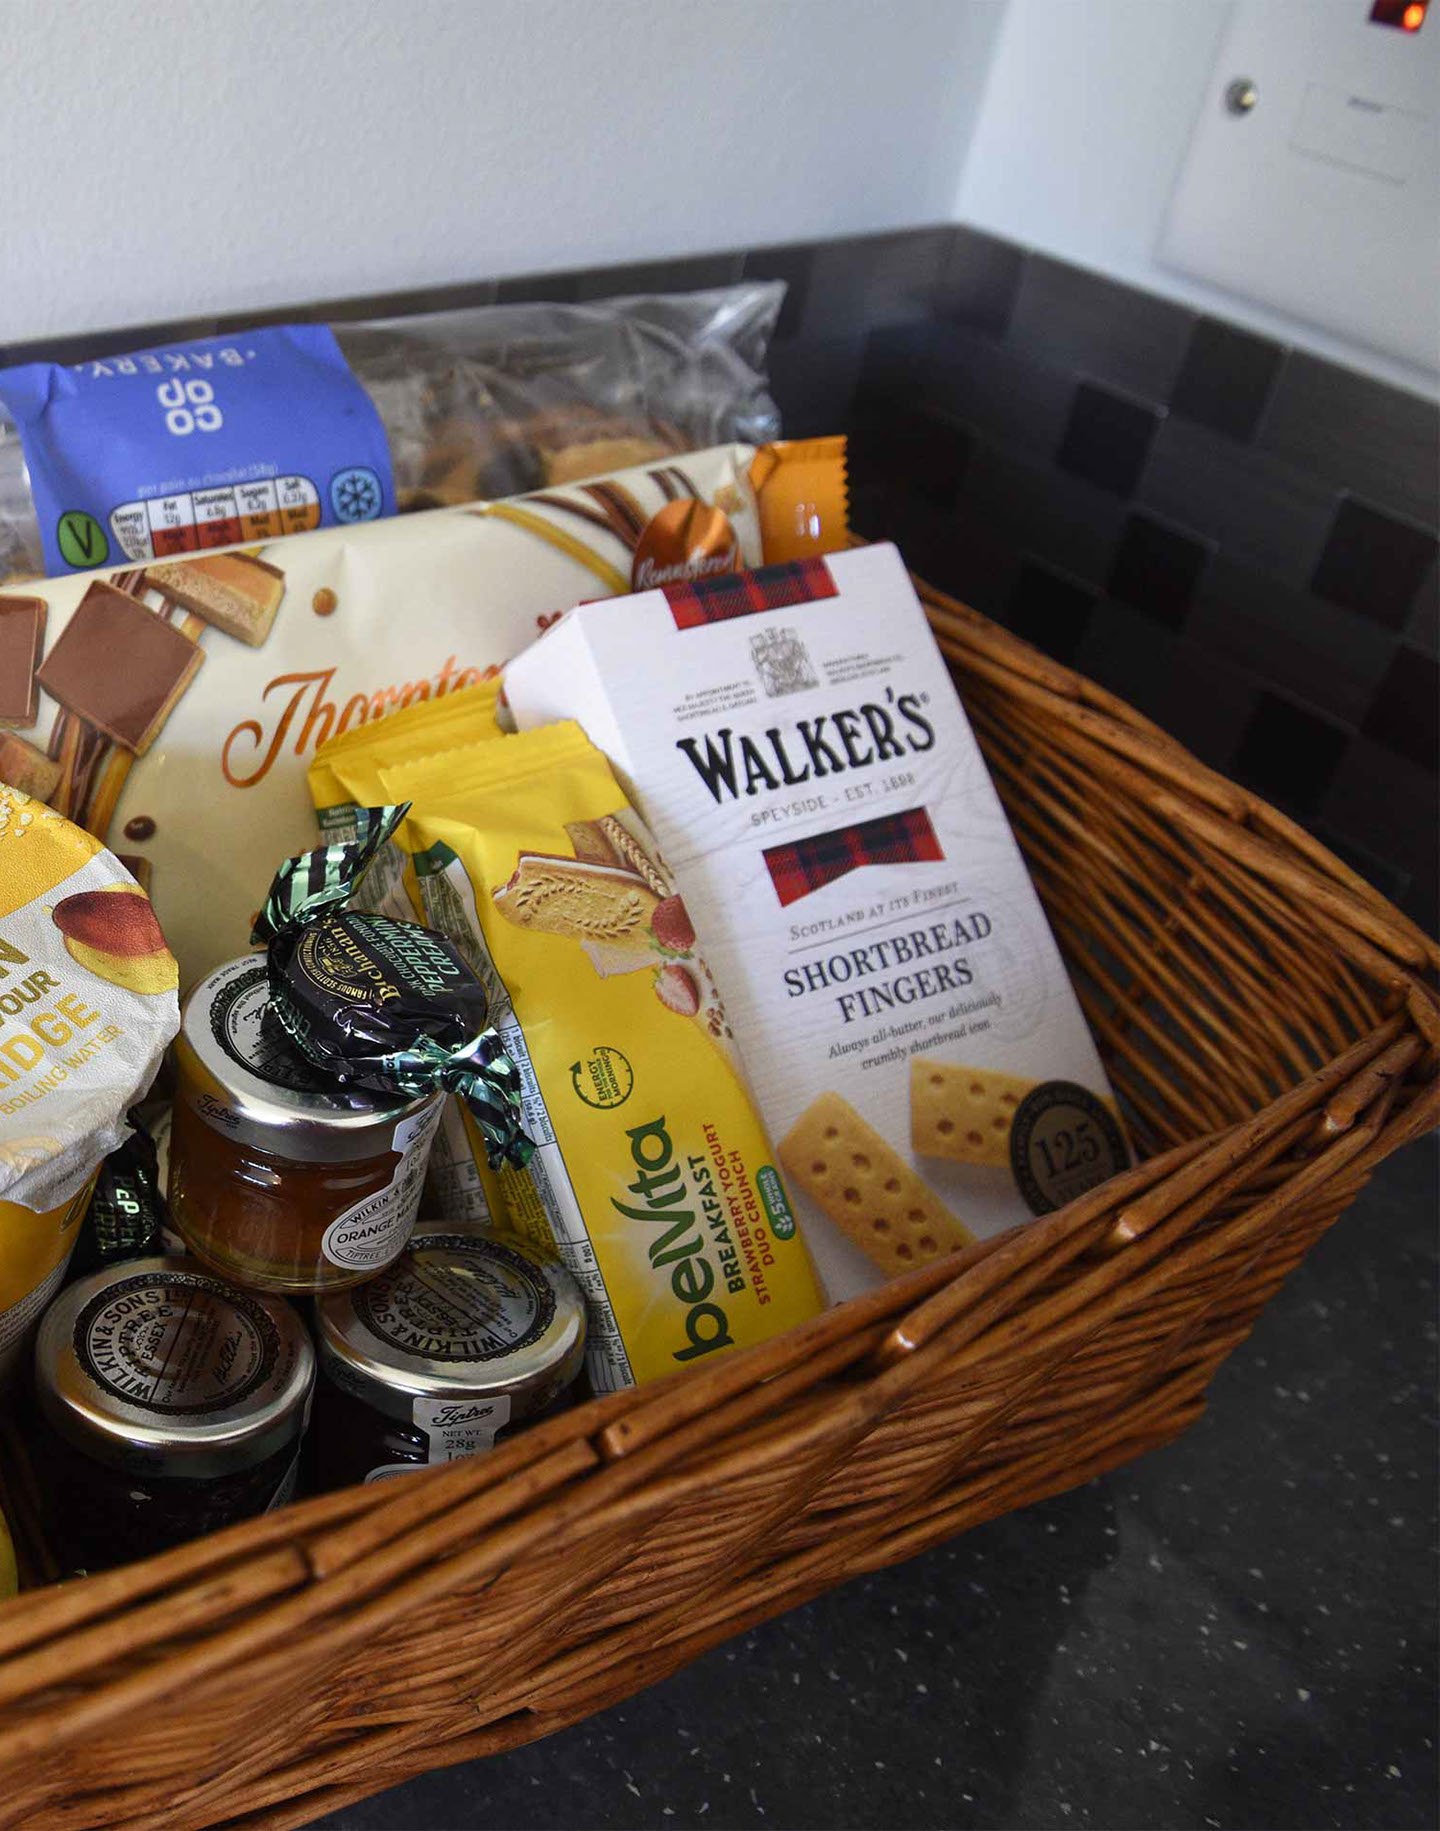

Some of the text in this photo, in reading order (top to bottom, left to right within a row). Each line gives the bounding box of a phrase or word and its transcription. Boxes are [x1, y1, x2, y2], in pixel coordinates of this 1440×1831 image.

[92, 348, 245, 378] BAKERY
[677, 686, 936, 804] WALKER'S
[749, 794, 828, 828] SPEYSIDE
[789, 881, 960, 941] SCOTLAND AT ITS FINEST
[323, 917, 402, 1000] Bchanan's
[374, 943, 415, 981] CHOCOLATE
[783, 911, 994, 999] SHORTBREAD
[313, 965, 367, 1000] FAMOUS SCOTTISH
[835, 957, 974, 1025] FINGERS
[827, 991, 1004, 1061] Always all-butter, our deliciously
[514, 1035, 525, 1058] biscuit
[860, 1026, 967, 1070] crumbly shortbread
[0, 1063, 68, 1127] BOILING
[66, 1026, 124, 1072] WATER
[523, 1067, 537, 1094] biscuits
[587, 1060, 608, 1102] ENERGY
[602, 1052, 621, 1097] MORNING
[538, 1117, 553, 1142] biscuits
[1034, 1120, 1102, 1178] 125
[350, 1196, 389, 1225] WILKIN
[687, 1155, 746, 1294] BREAKFAST
[702, 1123, 771, 1306] STRAWBERRY YOGURT
[728, 1150, 775, 1267] DUO CRUNCH
[771, 1200, 787, 1216] 5
[337, 1218, 395, 1244] ORANGE
[346, 1249, 382, 1260] TIPTREE
[581, 1244, 590, 1258] 100
[104, 1289, 161, 1324] SONS
[95, 1325, 115, 1336] &
[142, 1321, 168, 1362] ESSEX
[391, 1323, 409, 1337] &
[406, 1332, 504, 1355] WILKIN
[92, 1336, 152, 1401] WILKIN
[430, 1405, 495, 1427] Tiptree
[445, 1438, 477, 1451] 28g
